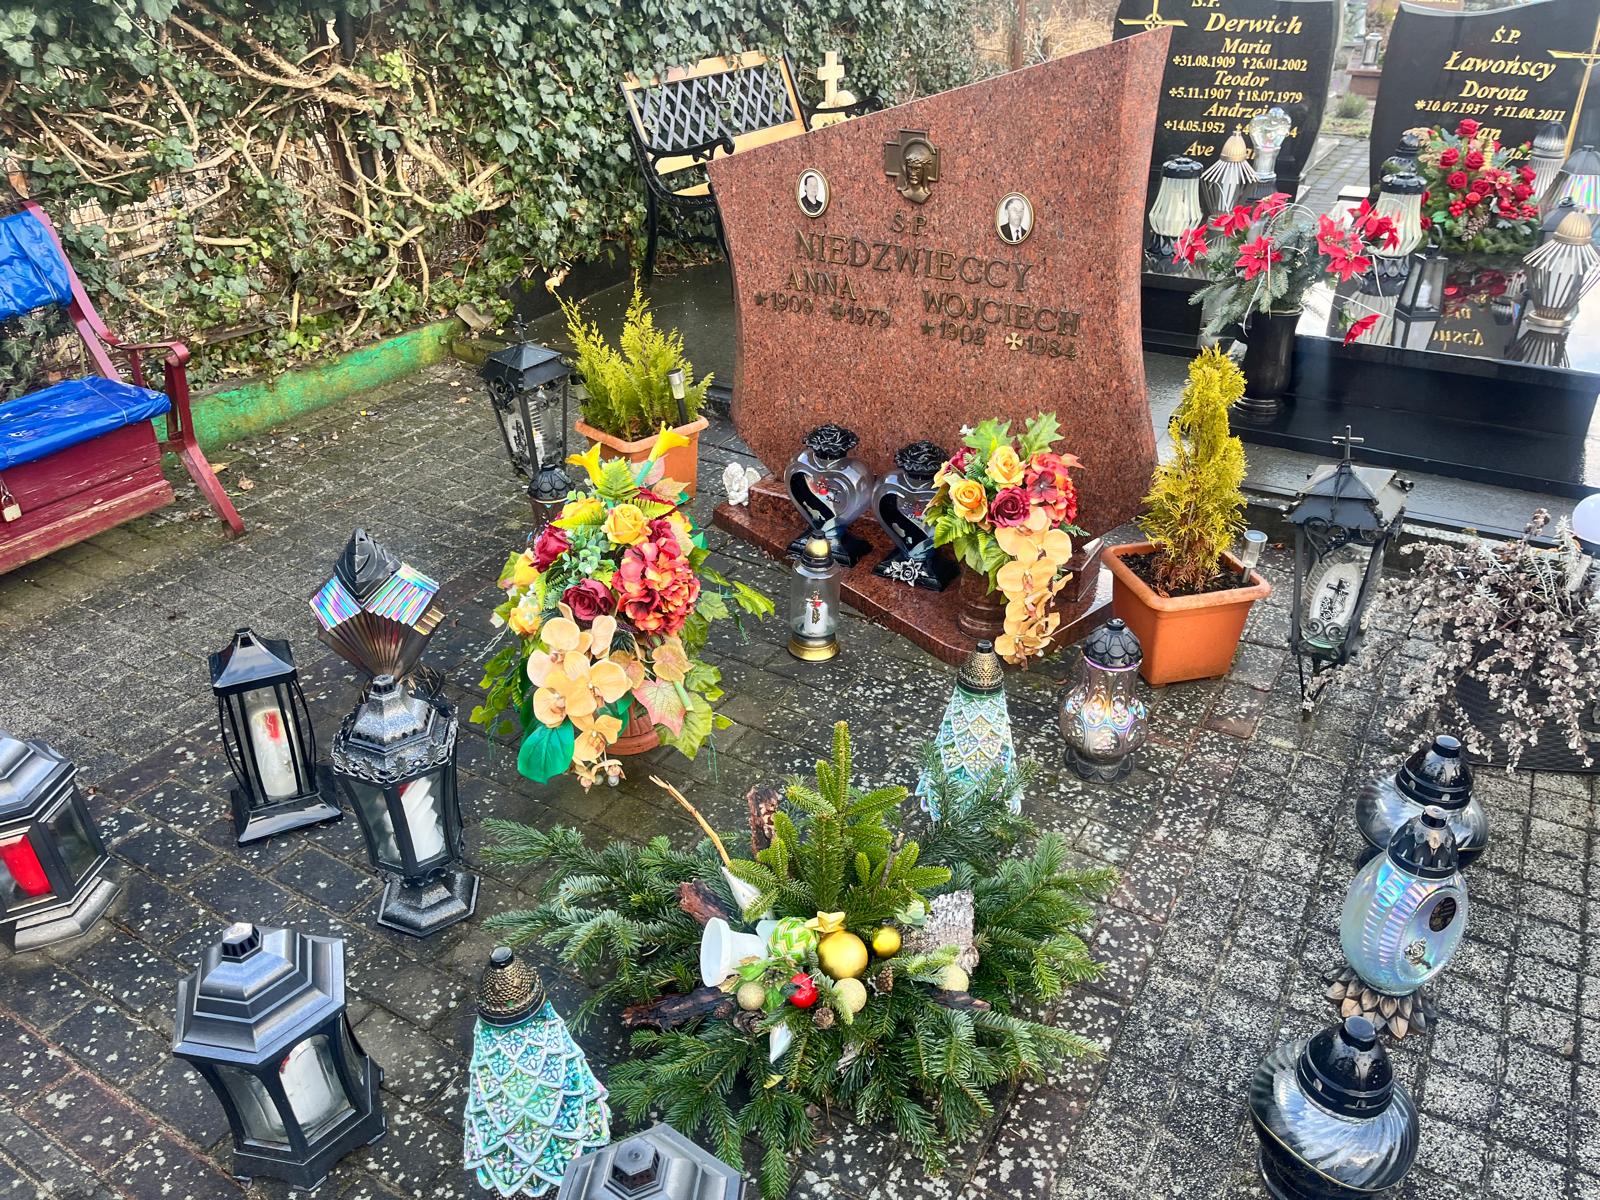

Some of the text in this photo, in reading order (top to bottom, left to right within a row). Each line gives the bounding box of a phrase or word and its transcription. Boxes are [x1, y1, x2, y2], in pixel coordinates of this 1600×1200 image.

[1203, 12, 1303, 34] Derwich
[1221, 37, 1272, 54] Maria
[1490, 25, 1521, 44] Ś.P.
[1443, 50, 1557, 81] Ławońscy
[1214, 70, 1269, 87] Teodor
[1458, 79, 1529, 102] Dorota
[1475, 122, 1502, 140] an
[1183, 140, 1215, 156] Ave
[795, 229, 1033, 292] NIEDZWIECCY
[785, 266, 858, 300] ANNA
[922, 288, 1081, 337] WOJCIECH
